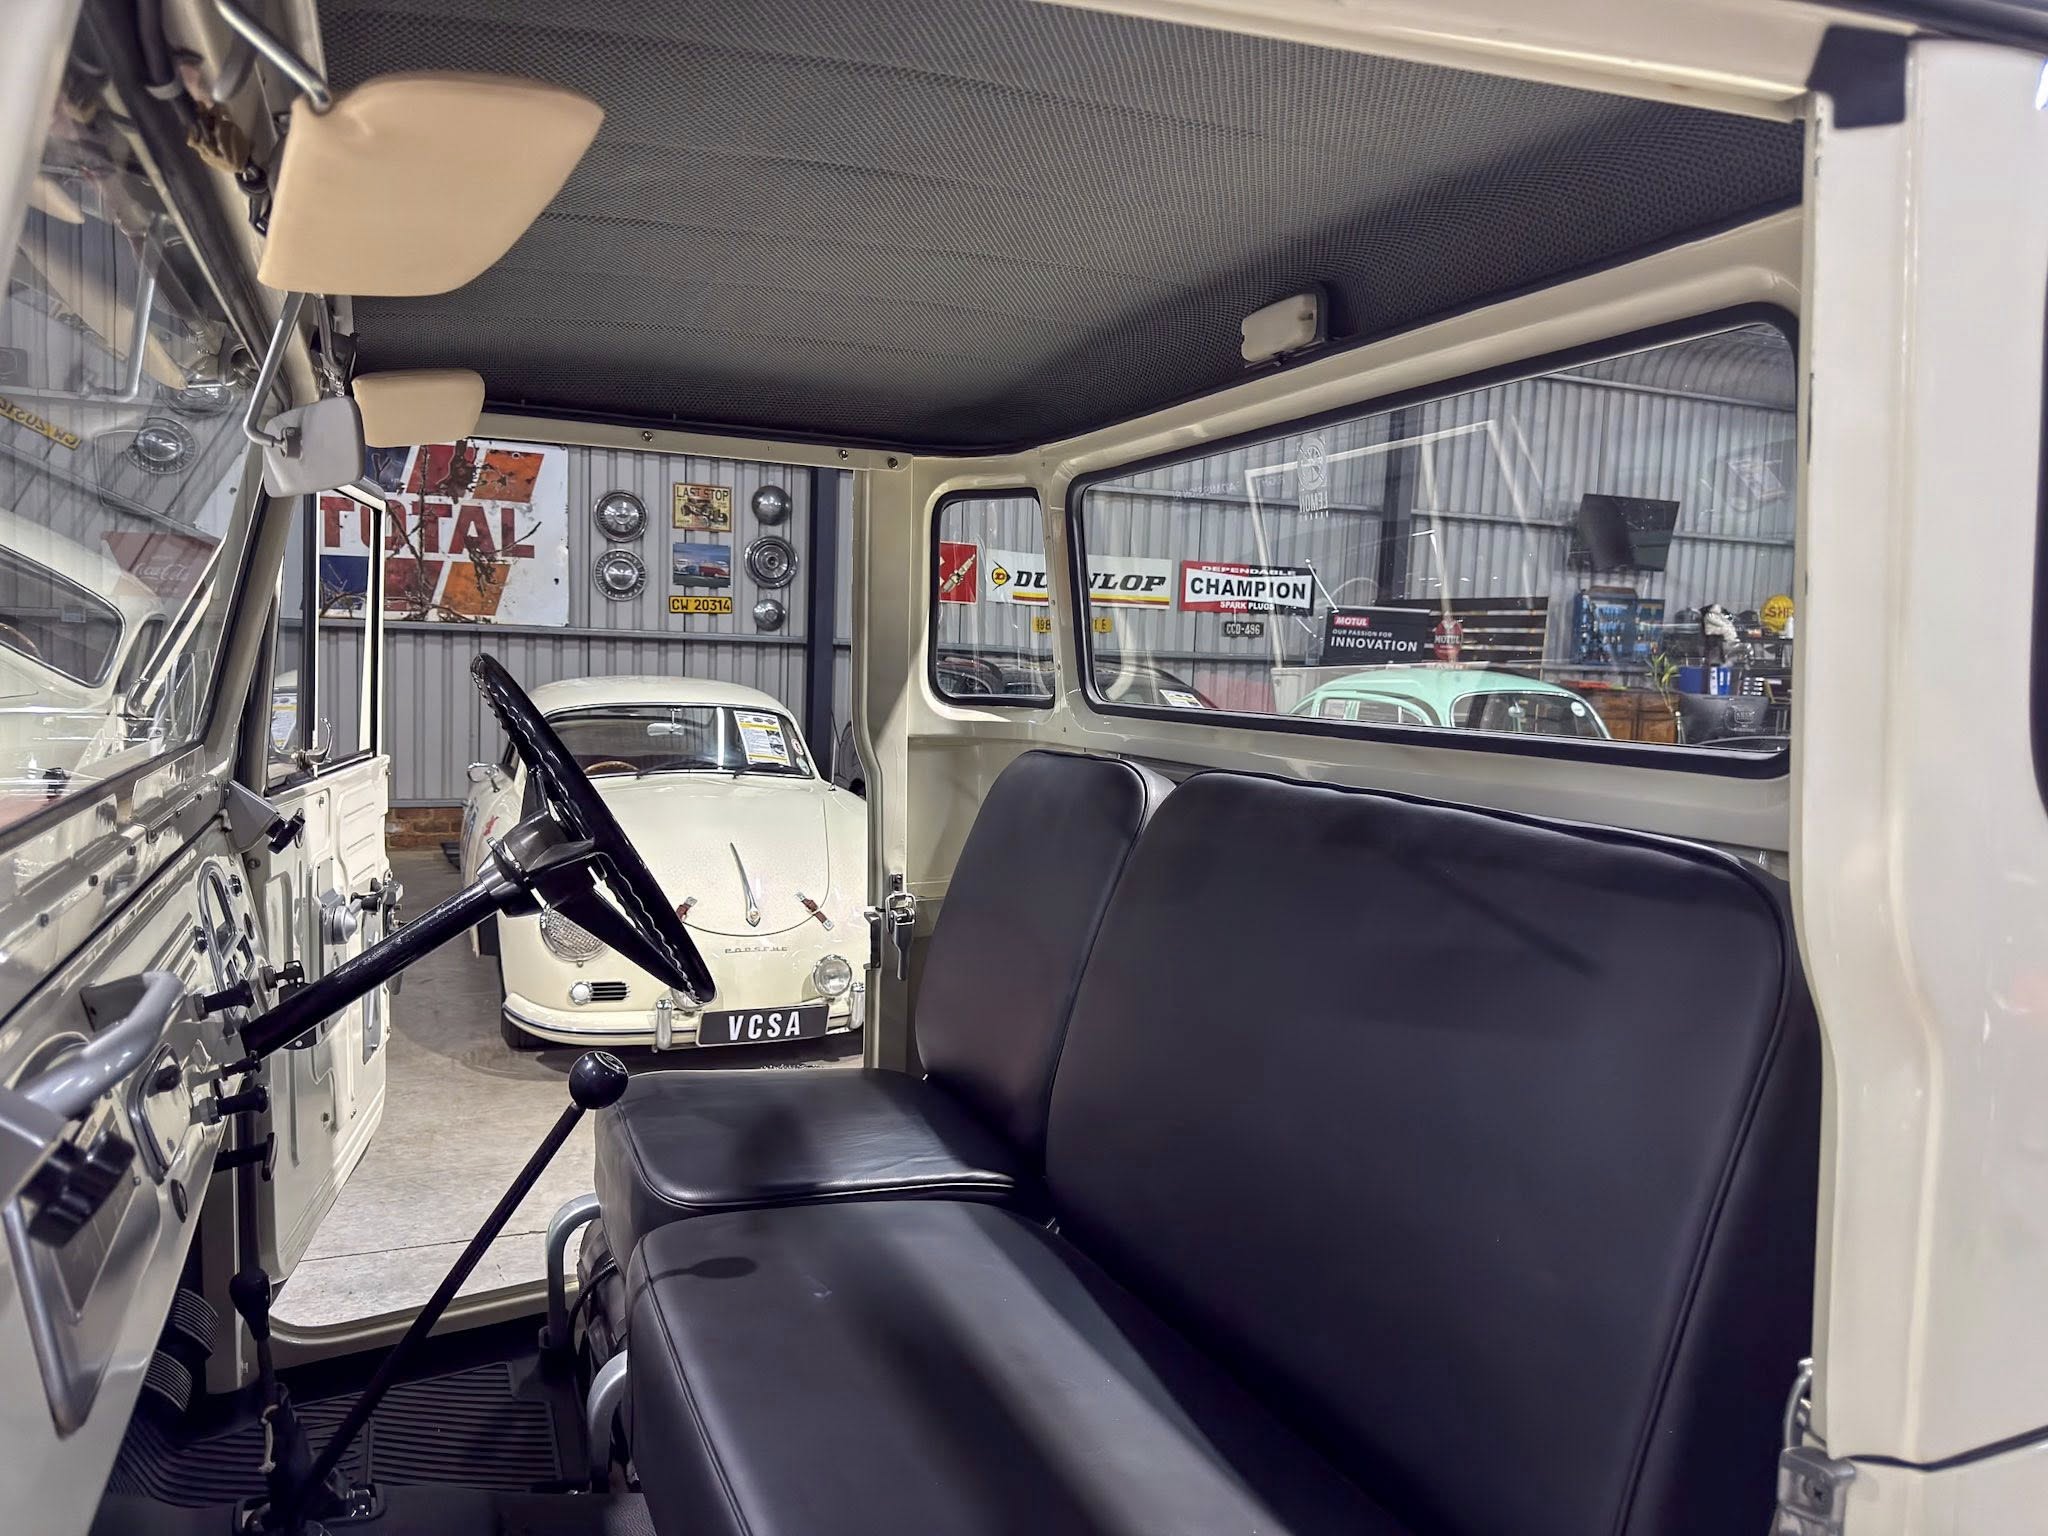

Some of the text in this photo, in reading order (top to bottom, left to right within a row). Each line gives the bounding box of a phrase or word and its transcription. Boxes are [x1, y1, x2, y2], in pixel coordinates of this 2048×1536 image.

[676, 486, 728, 501] LAST STOP
[320, 496, 535, 558] TOTAL
[1202, 565, 1296, 576] DEPENDABLE
[1190, 577, 1306, 600] CHAMPION
[672, 598, 731, 611] CW 20314
[1220, 600, 1275, 611] SPARK PLUGS
[1335, 616, 1368, 626] MOTUL
[1348, 629, 1377, 637] PASSION
[1434, 634, 1460, 644] MOTUL
[1331, 636, 1418, 652] INNOVATION
[728, 1011, 801, 1041] VCSA
